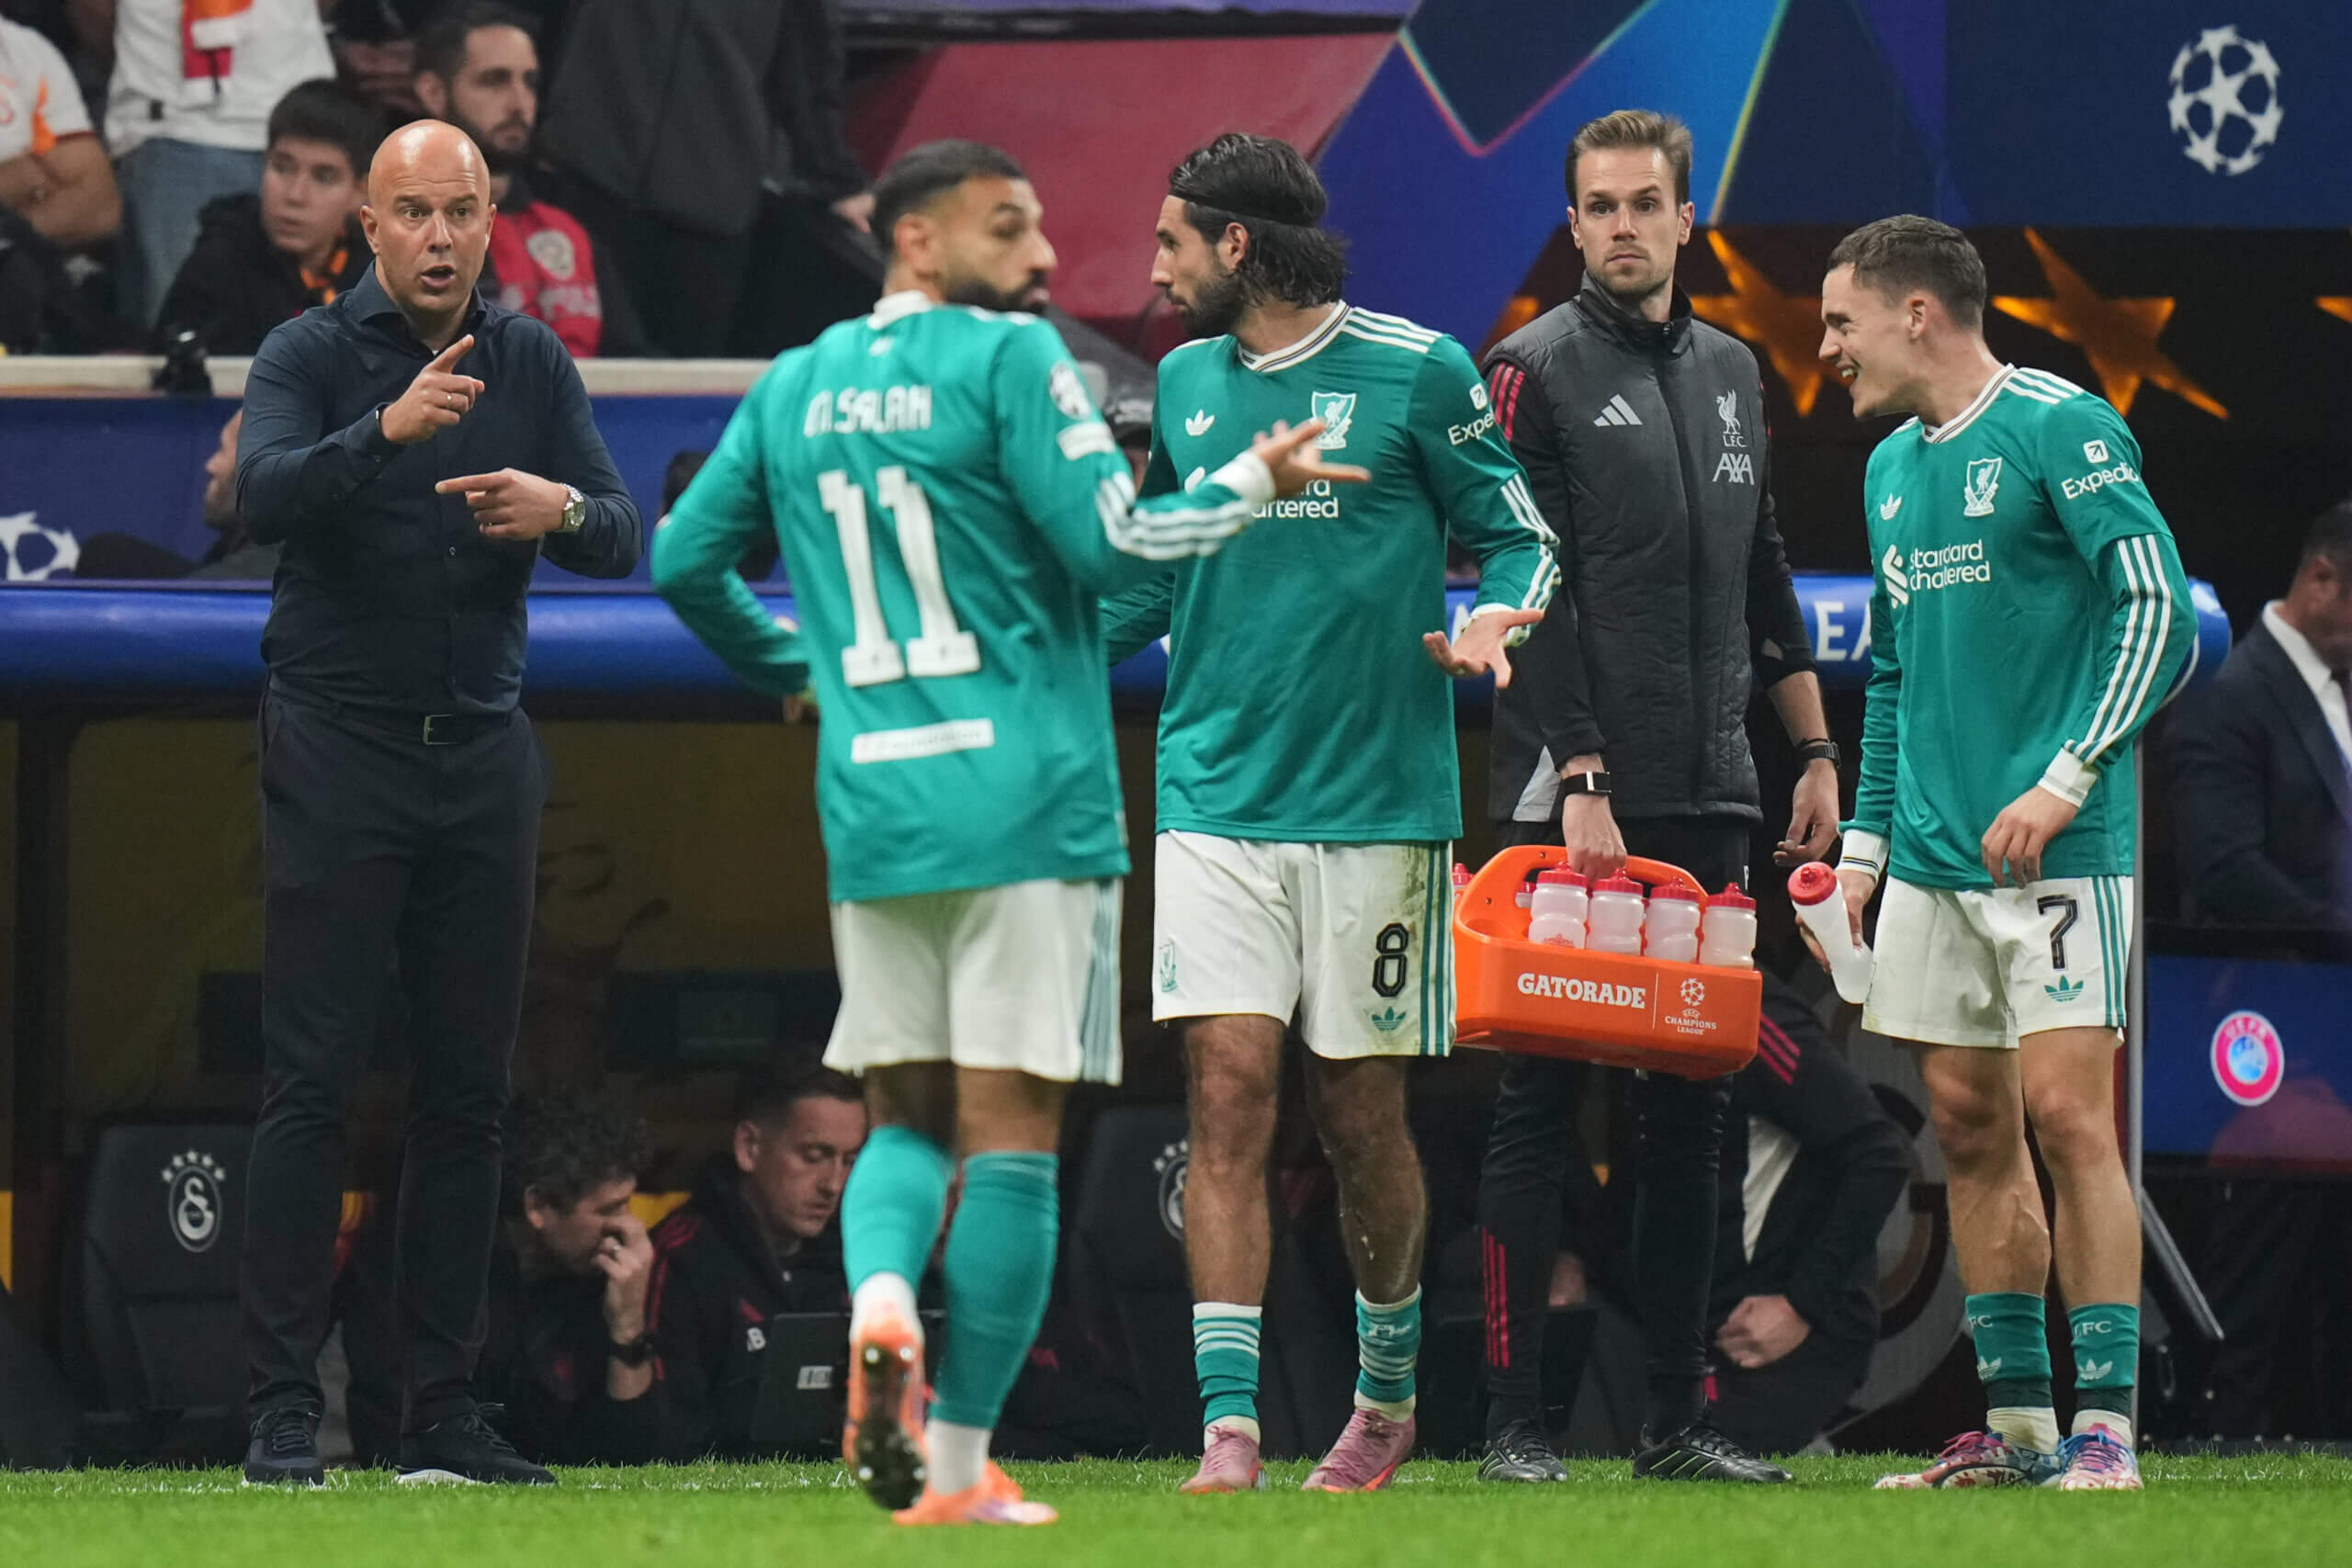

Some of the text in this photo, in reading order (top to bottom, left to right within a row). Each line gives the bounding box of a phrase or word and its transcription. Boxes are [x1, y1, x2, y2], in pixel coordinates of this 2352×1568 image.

[1447, 412, 1495, 446] Expe
[1712, 453, 1755, 486] AXA
[817, 465, 981, 687] 11
[2036, 895, 2079, 970] 7
[1372, 922, 1409, 998] 8
[1517, 972, 1646, 1009] GATORADE
[1665, 1015, 1717, 1029] CHAMPIONS
[1677, 1025, 1704, 1036] LEAGUE
